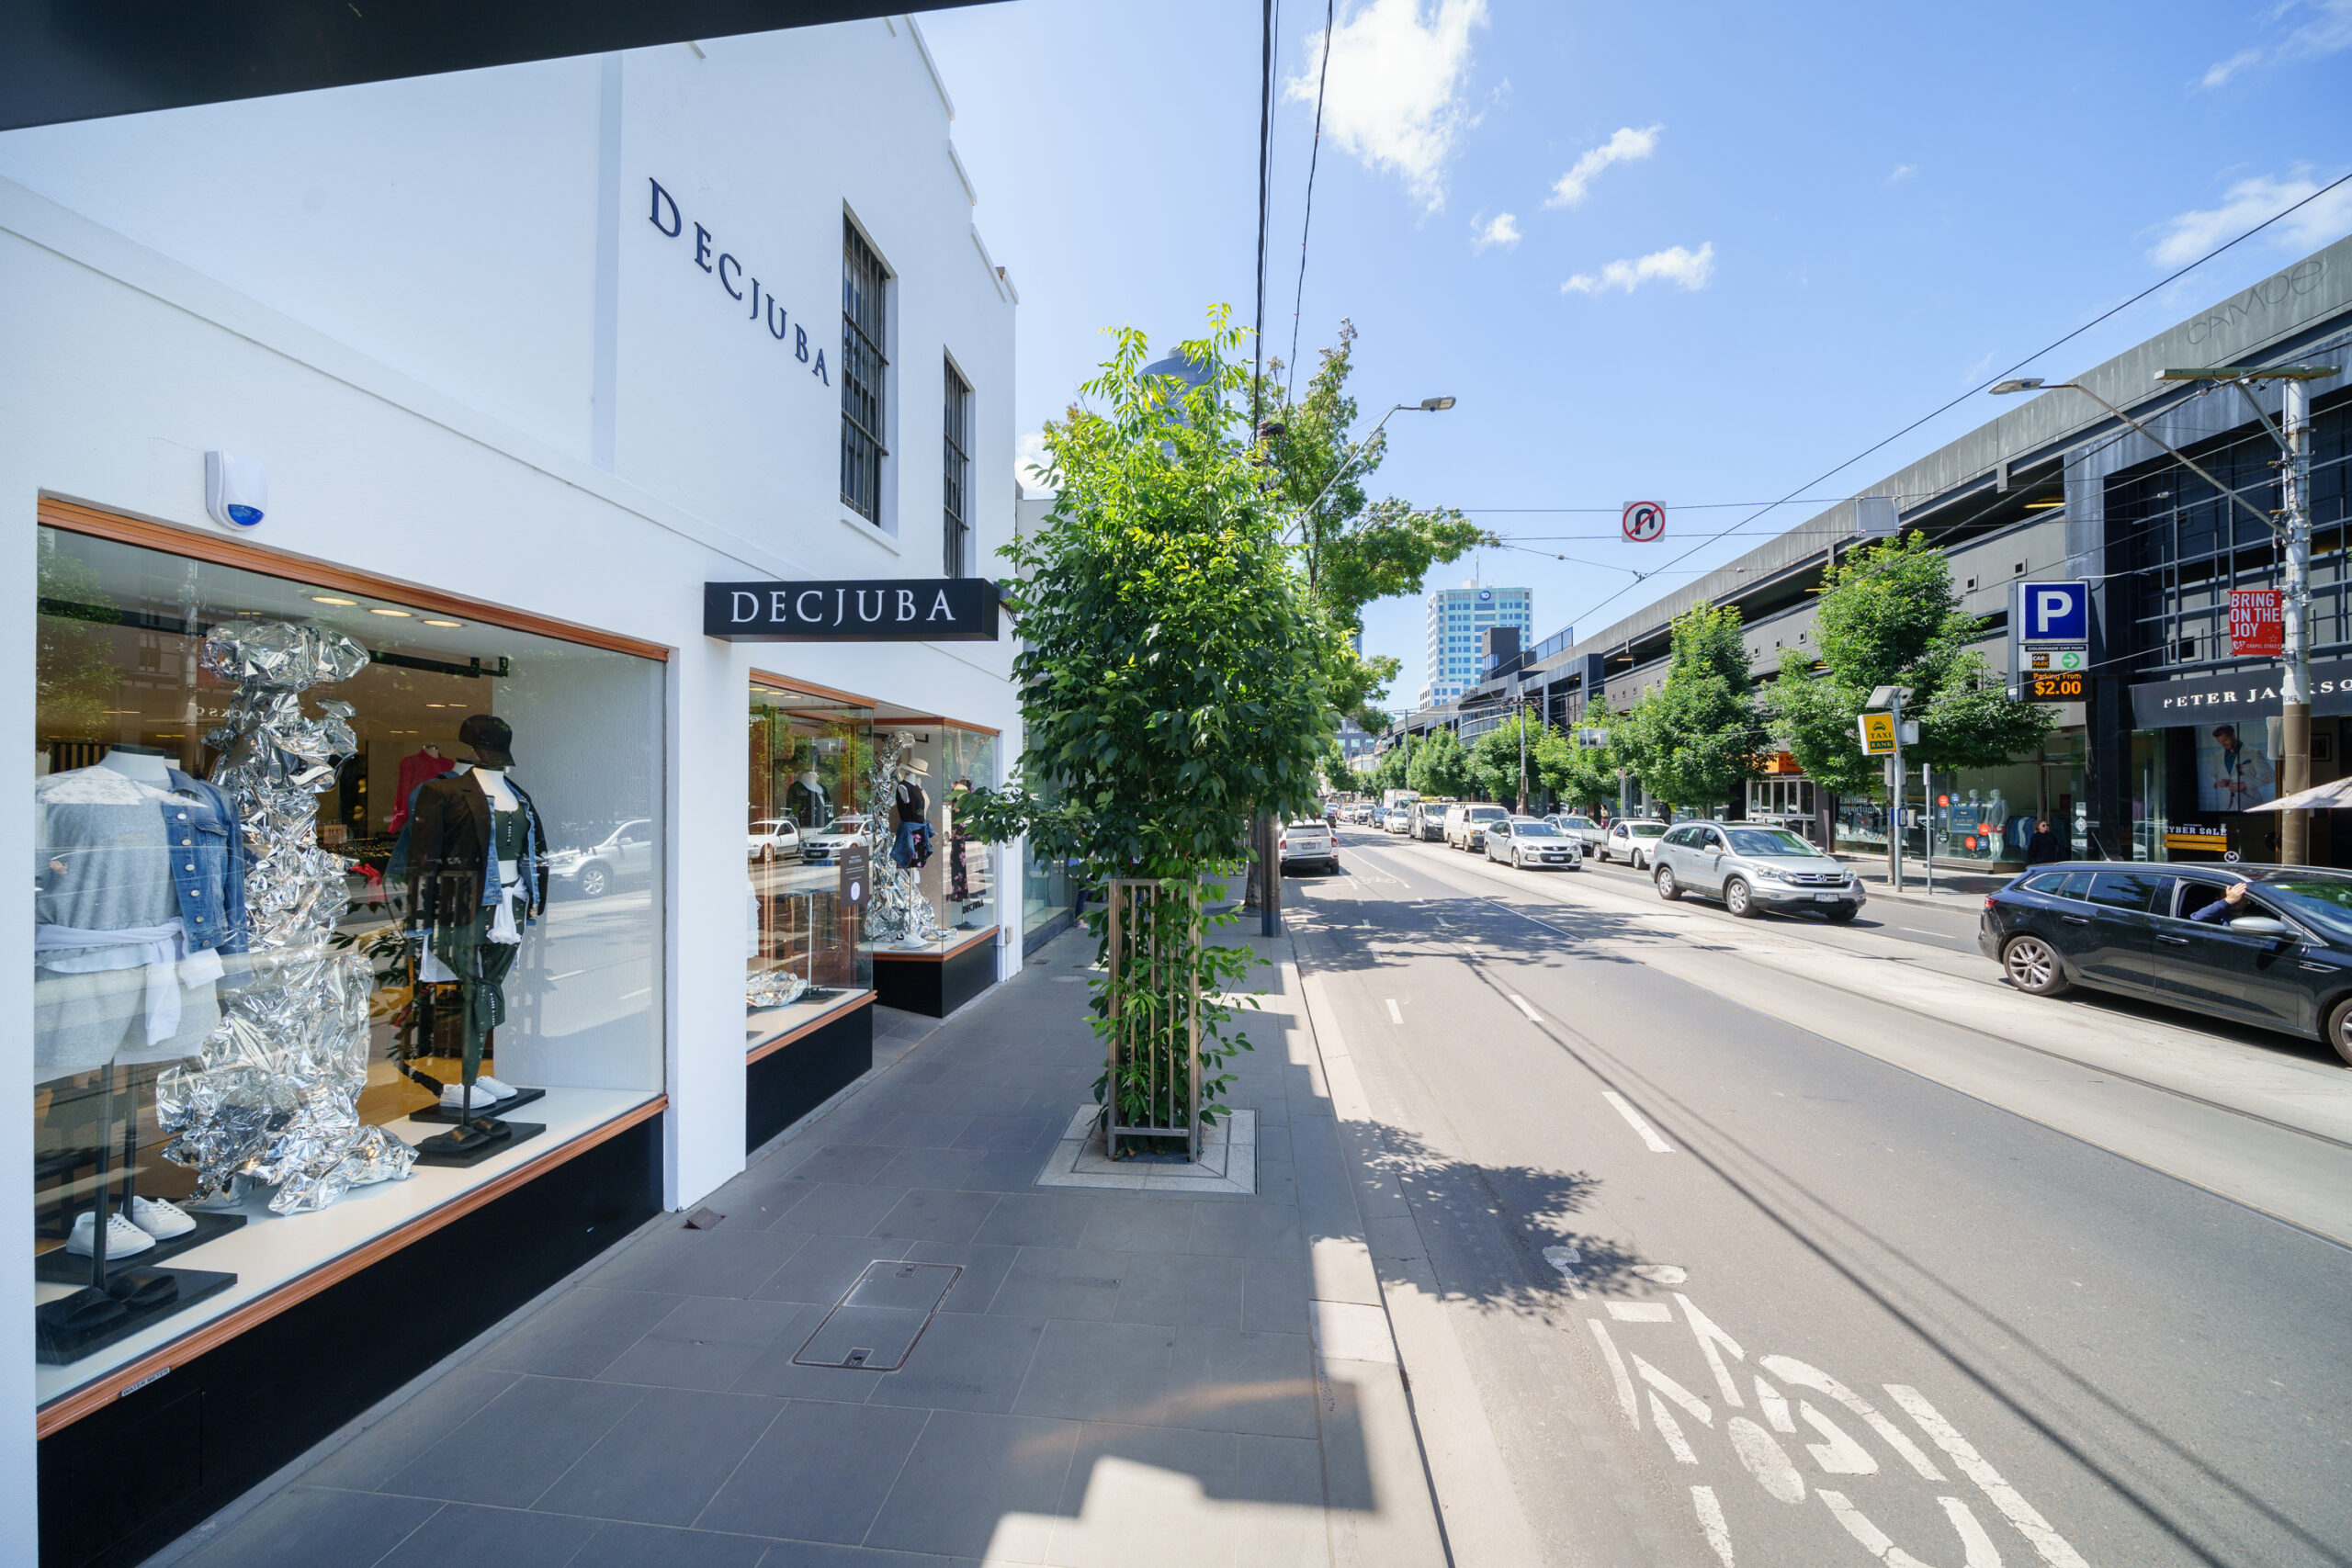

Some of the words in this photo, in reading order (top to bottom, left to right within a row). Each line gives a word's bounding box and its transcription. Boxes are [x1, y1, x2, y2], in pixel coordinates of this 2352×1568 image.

[649, 177, 830, 387] DECJUBA
[2231, 592, 2275, 607] BRING
[730, 589, 956, 626] DECJUBA
[2038, 591, 2073, 632] P
[2230, 608, 2251, 623] ON
[2254, 607, 2280, 622] THE
[2232, 623, 2258, 637] JOY
[2033, 672, 2060, 681] Parking
[2034, 681, 2082, 695] $2.00
[2164, 691, 2238, 708] PETER
[2199, 827, 2227, 836] SALE
